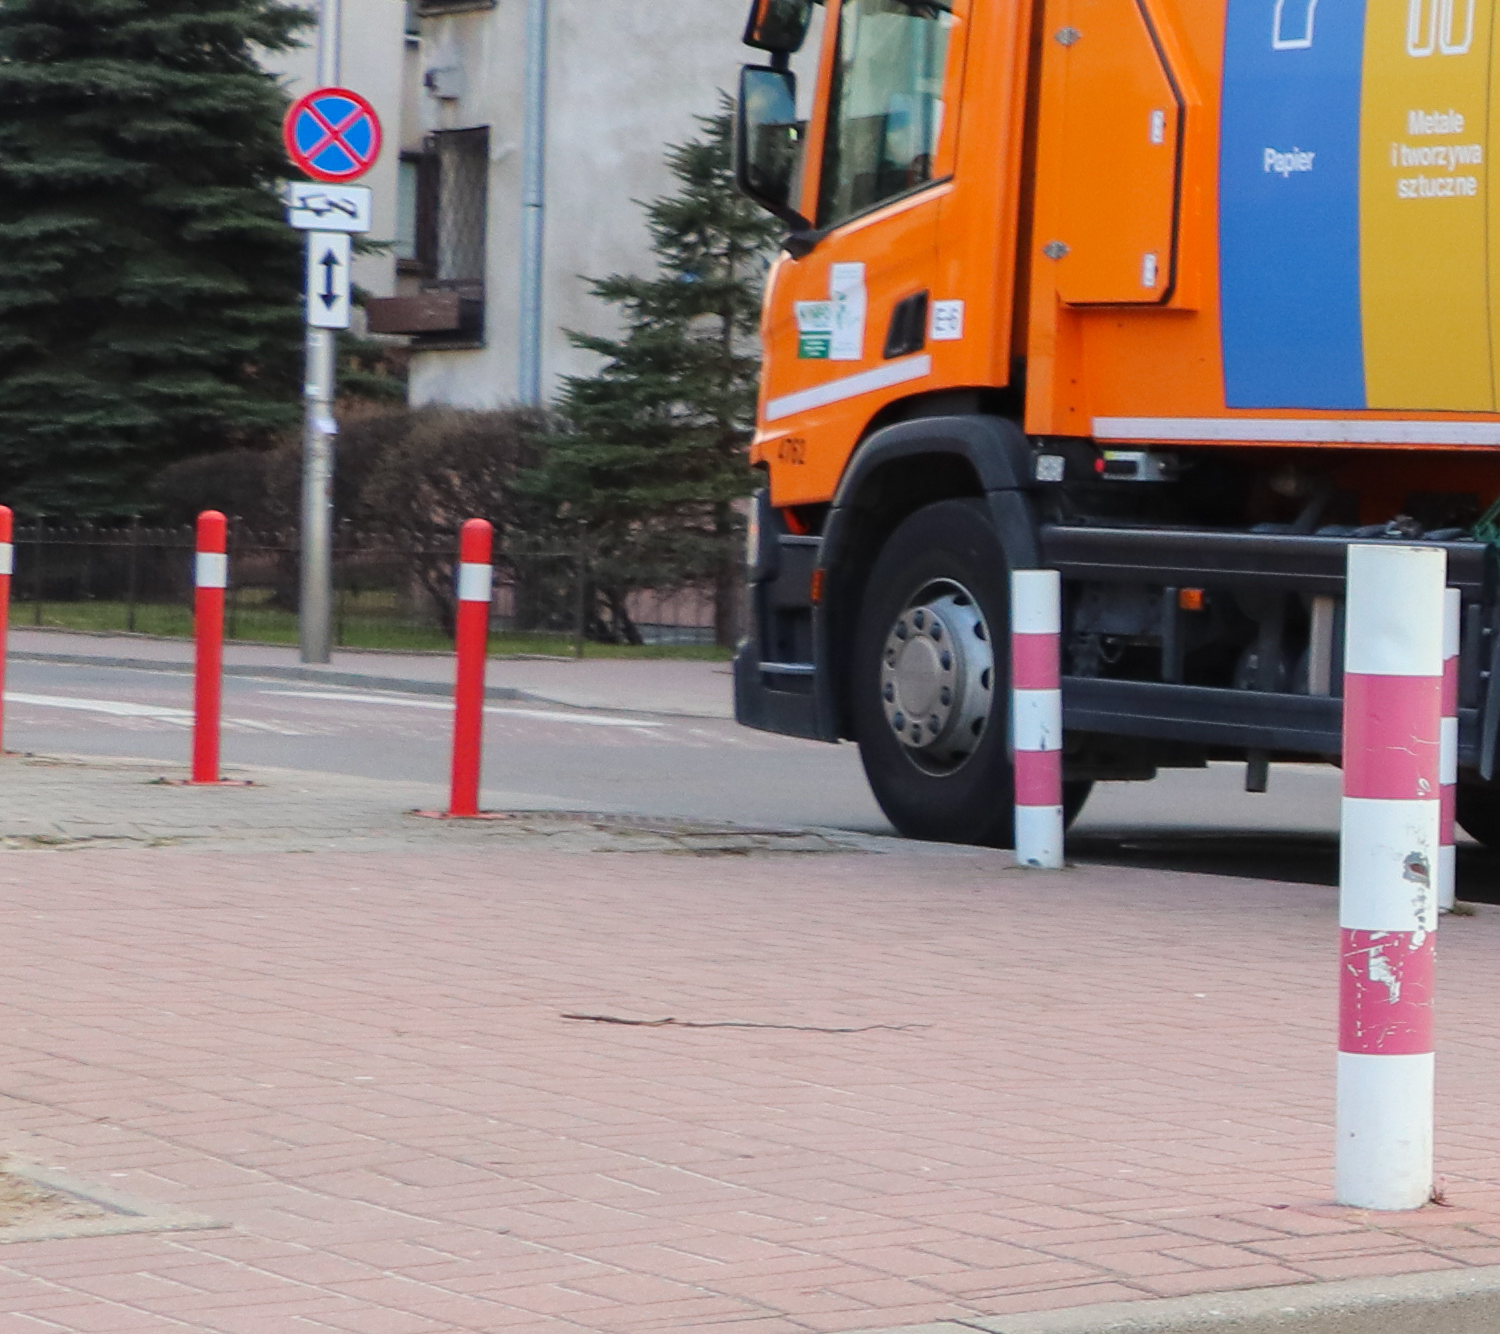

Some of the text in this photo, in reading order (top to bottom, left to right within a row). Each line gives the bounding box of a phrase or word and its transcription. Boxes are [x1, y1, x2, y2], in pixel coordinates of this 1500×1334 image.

[1408, 109, 1466, 135] Metale
[1263, 145, 1316, 178] Papier
[1391, 143, 1484, 172] i tworzywa
[1398, 174, 1478, 198] sztuczne
